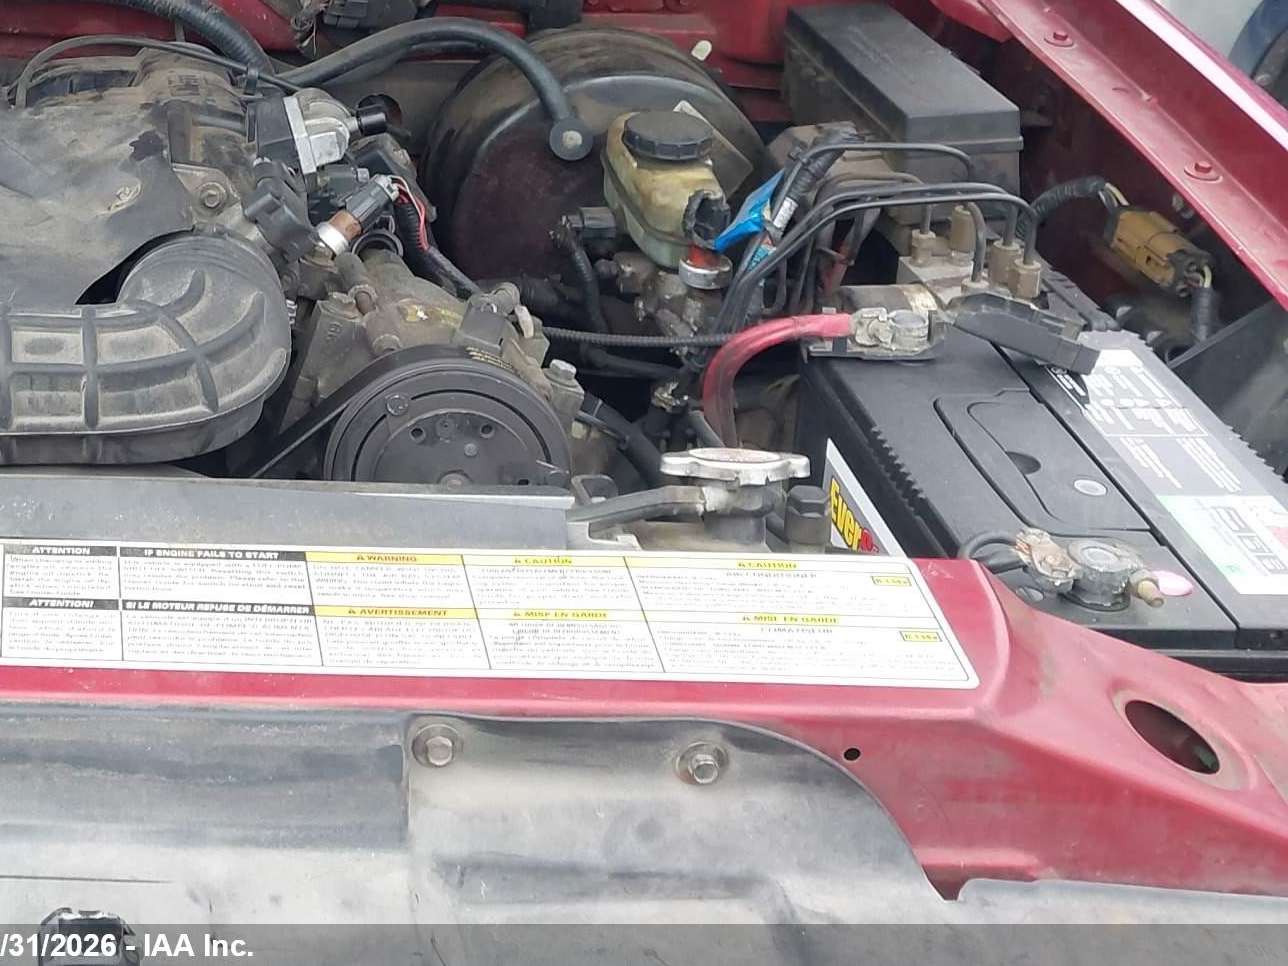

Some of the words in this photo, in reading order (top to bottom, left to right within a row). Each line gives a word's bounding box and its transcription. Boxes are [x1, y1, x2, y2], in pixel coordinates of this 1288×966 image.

[32, 546, 91, 555] ATTENTION
[144, 549, 154, 557] IF
[156, 549, 195, 558] ENGINE
[197, 550, 227, 559] FAILS
[229, 550, 243, 559] TO
[245, 551, 280, 560] START
[29, 599, 96, 609] ATTENTION!
[125, 601, 136, 610] SI
[138, 601, 151, 610] LE
[152, 602, 195, 611] MOTEUR
[197, 603, 235, 612] REFUSE
[237, 604, 252, 613] DE
[253, 602, 310, 614] DÉMARRER
[359, 609, 449, 617] AVERTISSEMENT
